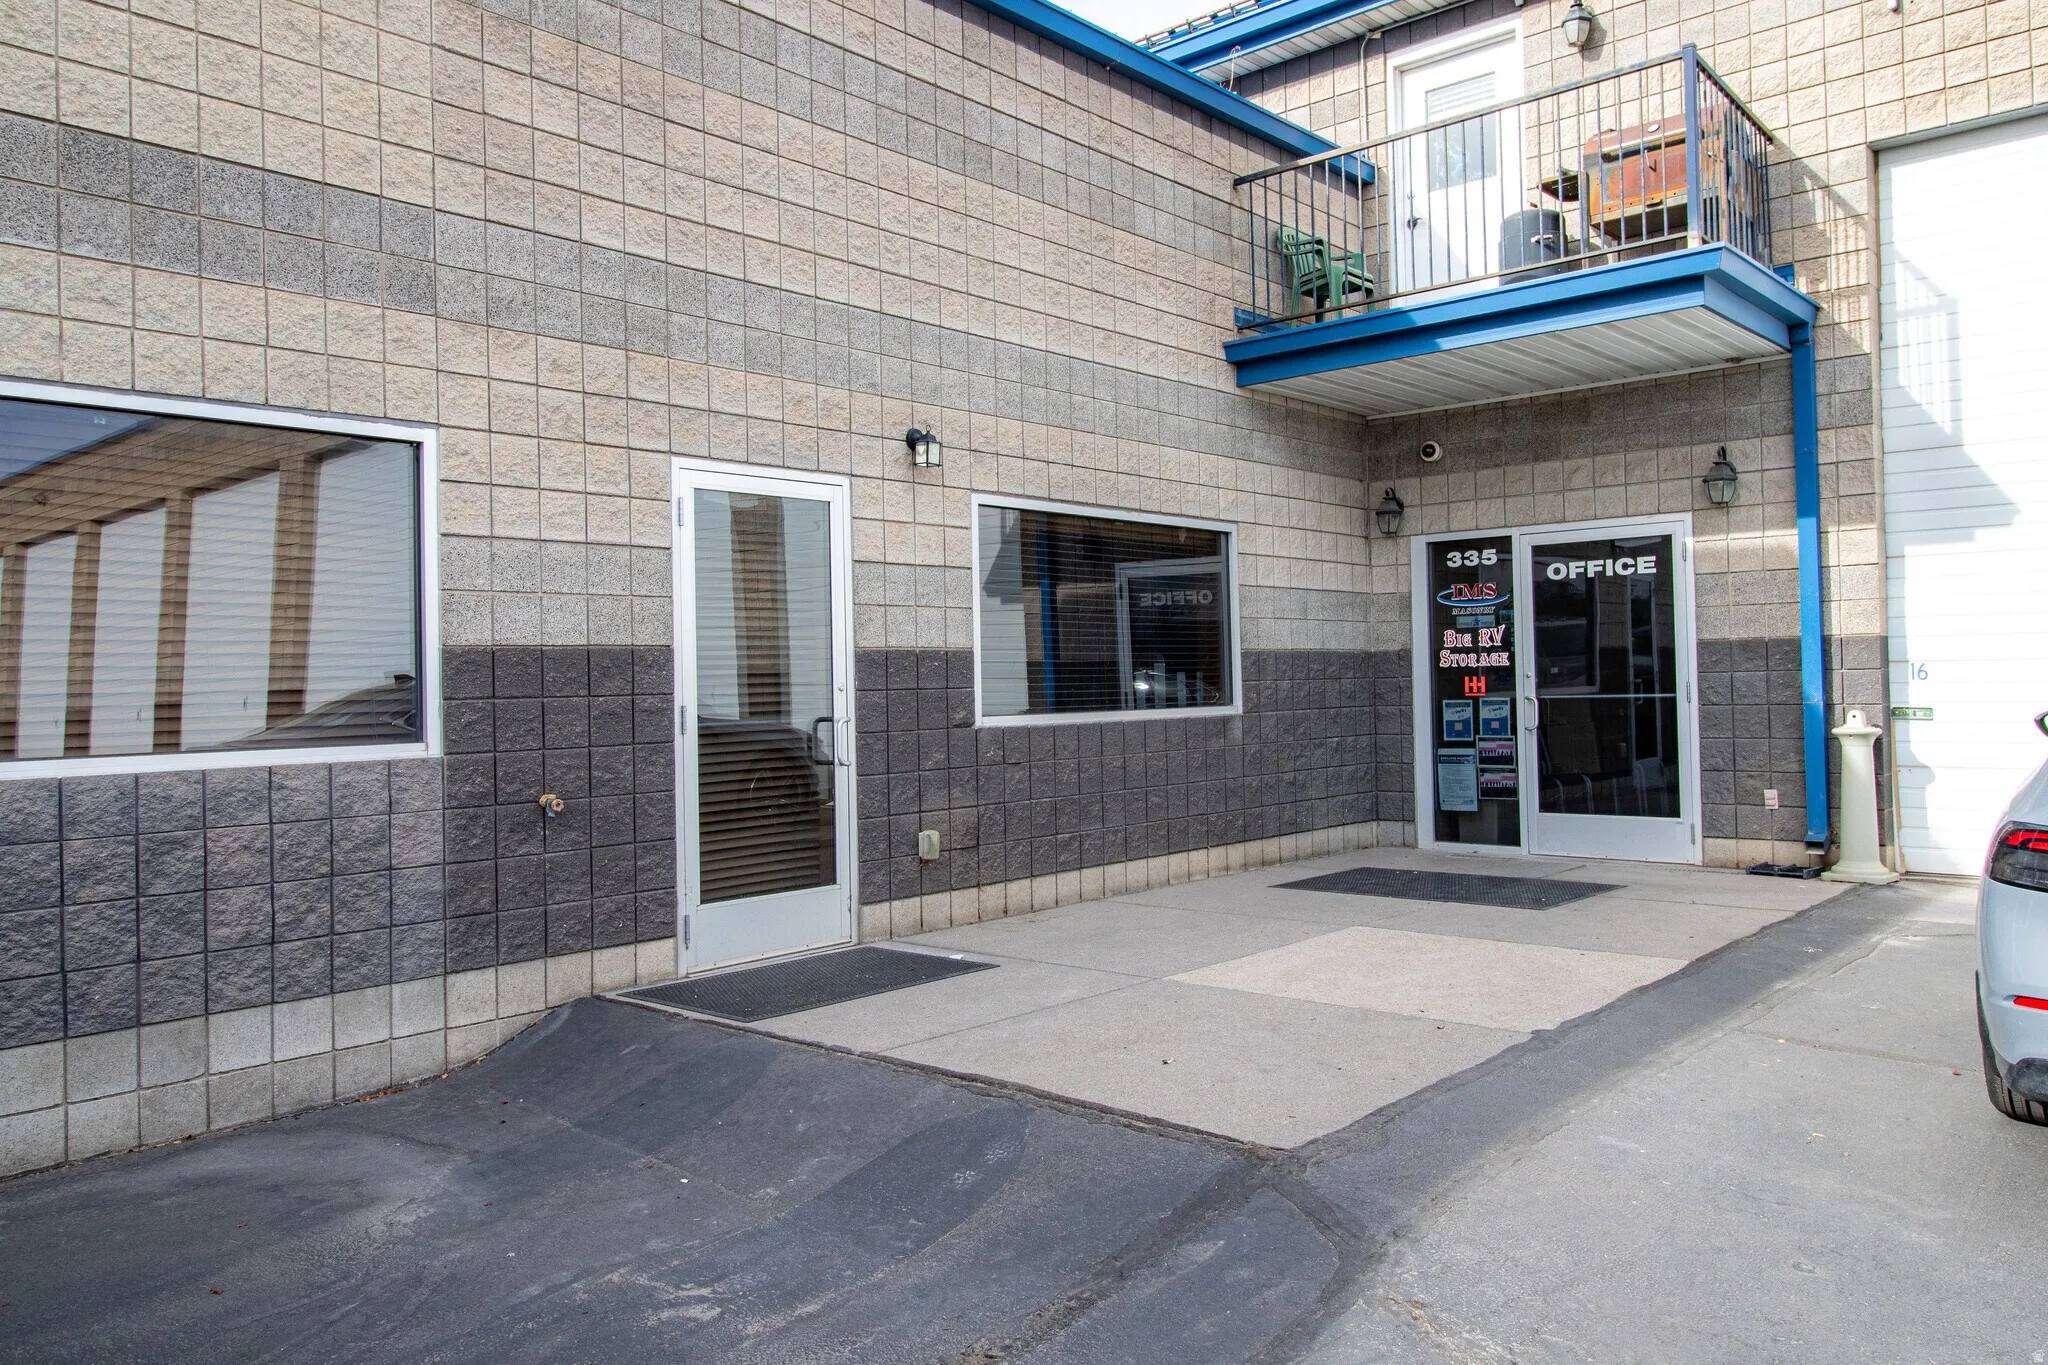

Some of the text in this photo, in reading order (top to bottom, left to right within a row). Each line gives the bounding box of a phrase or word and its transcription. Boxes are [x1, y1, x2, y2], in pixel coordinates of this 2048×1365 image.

[1446, 549, 1498, 568] 335
[1546, 555, 1657, 581] OFFICE
[1450, 582, 1498, 601] IMS
[1451, 606, 1496, 615] MASONRY
[1478, 624, 1506, 647] RV
[1910, 663, 1929, 681] 16
